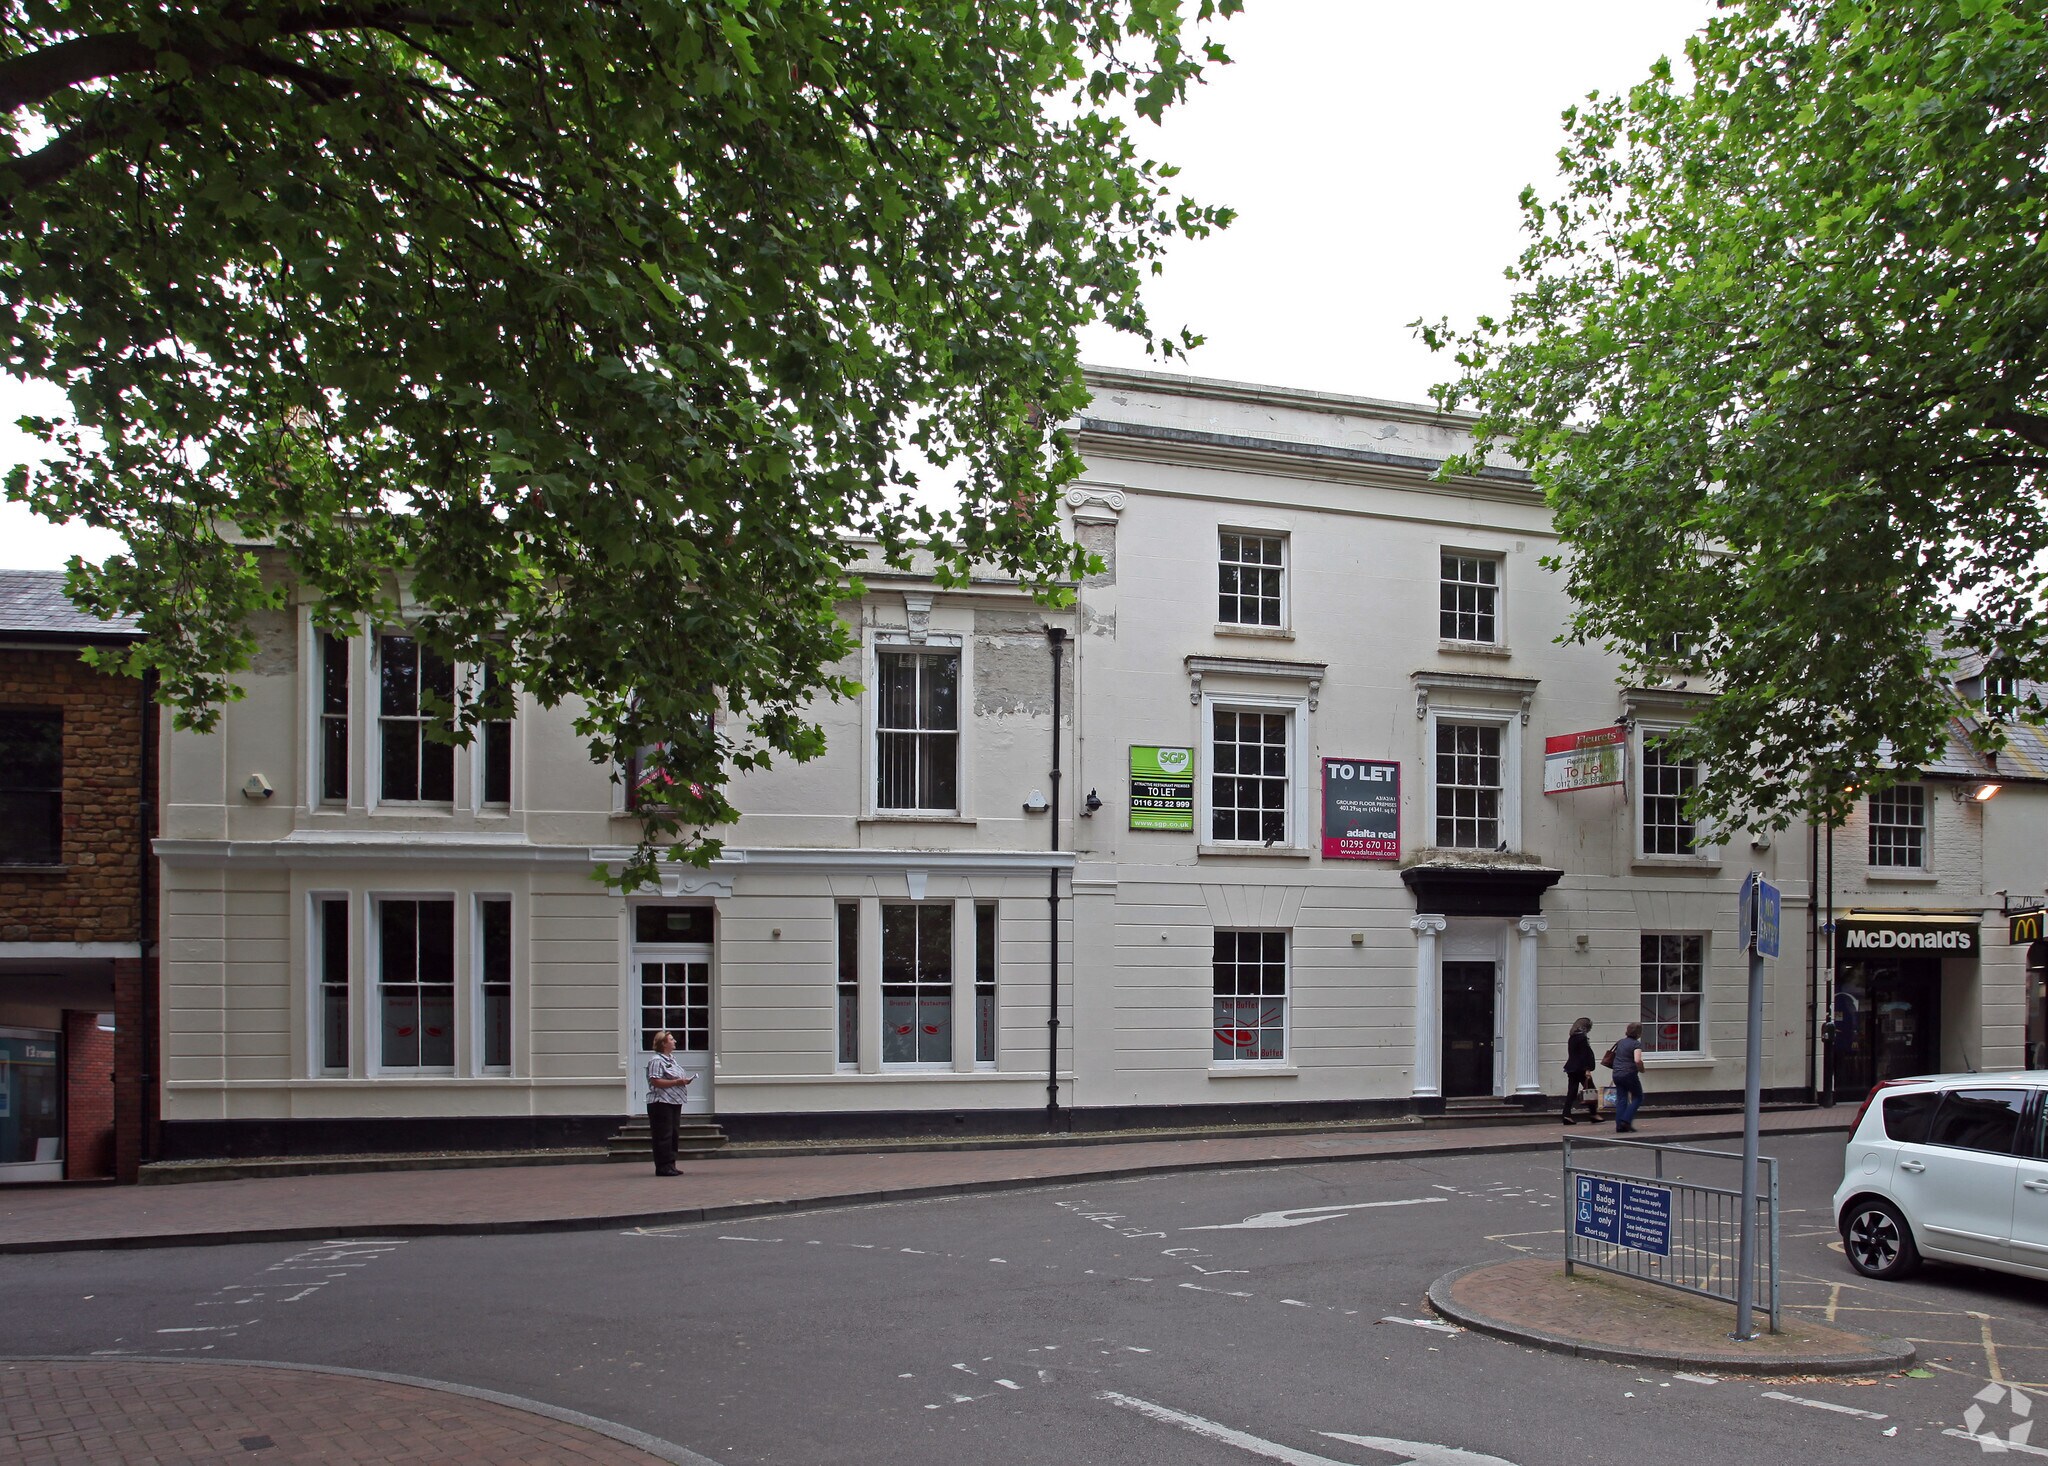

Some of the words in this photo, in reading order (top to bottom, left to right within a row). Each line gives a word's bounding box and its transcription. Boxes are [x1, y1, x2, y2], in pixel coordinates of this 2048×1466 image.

[1160, 752, 1186, 764] SGP
[1328, 764, 1354, 780] TO
[1360, 766, 1395, 782] LET
[1564, 767, 1578, 778] To
[1584, 763, 1603, 775] Let
[1148, 787, 1159, 796] TO
[1161, 788, 1176, 796] LET
[1346, 829, 1375, 837] adalta
[1378, 831, 1396, 839] real
[1340, 840, 1363, 848] 01295
[1846, 930, 1971, 949] McDonald's
[1261, 1048, 1283, 1056] Buffet
[1599, 1184, 1612, 1194] Blue
[1596, 1194, 1615, 1205] Badge
[1594, 1204, 1616, 1216] holders
[1598, 1217, 1612, 1227] only
[1585, 1226, 1597, 1235] Short
[1598, 1230, 1609, 1239] stay
[1635, 1223, 1662, 1236] information
[1626, 1230, 1639, 1239] board
[1647, 1235, 1663, 1244] details
